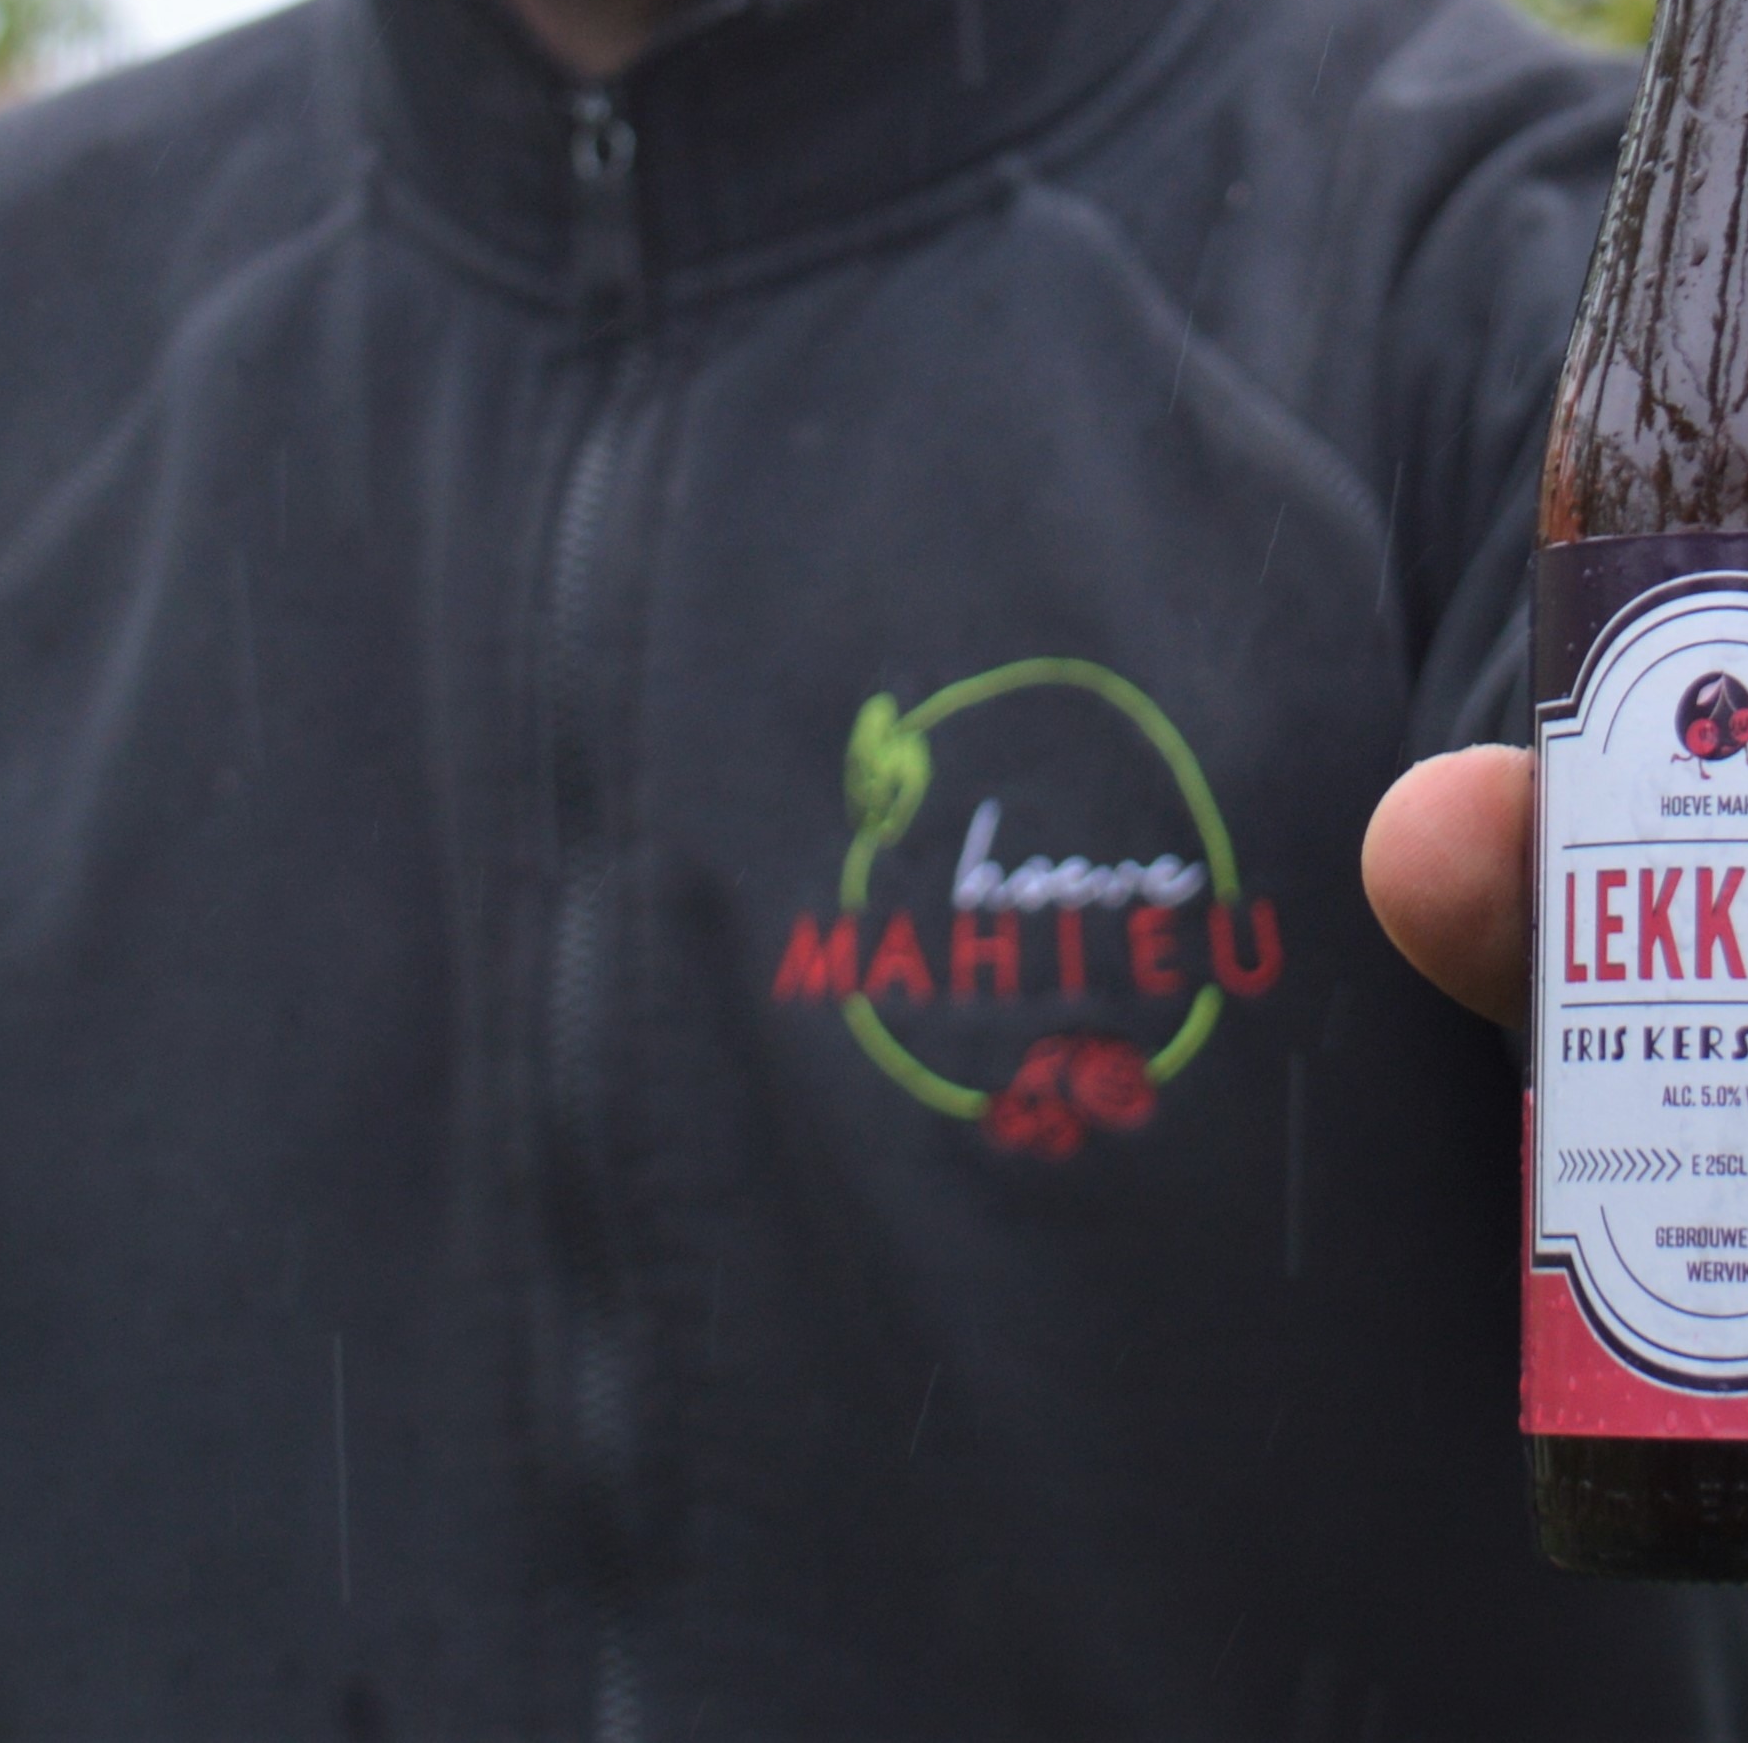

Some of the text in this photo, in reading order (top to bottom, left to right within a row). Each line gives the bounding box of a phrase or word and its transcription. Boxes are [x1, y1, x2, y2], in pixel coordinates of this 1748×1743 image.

[1661, 795, 1712, 816] HOEVE
[770, 896, 1284, 1005] MAHIEU
[1562, 1026, 1627, 1063] FRIS
[1662, 1085, 1696, 1107] ALC.
[1700, 1085, 1742, 1107] 5.0%
[1705, 1154, 1748, 1176] 25CL
